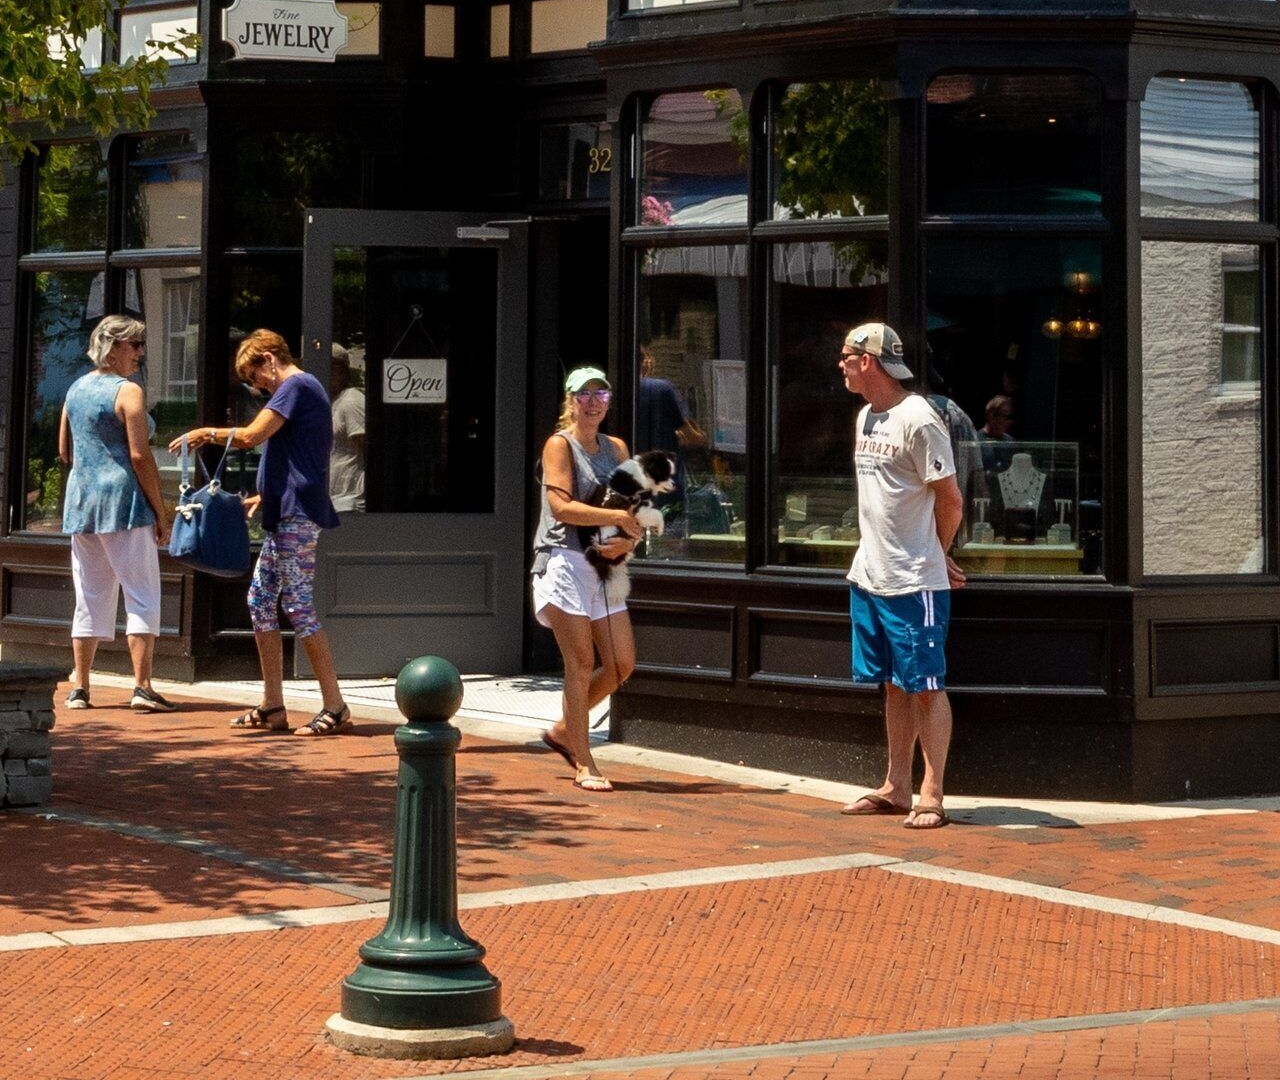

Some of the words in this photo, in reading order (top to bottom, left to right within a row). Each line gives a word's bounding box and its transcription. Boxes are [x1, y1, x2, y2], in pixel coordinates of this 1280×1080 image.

[272, 8, 300, 20] Fine
[239, 22, 334, 53] JEWELRY
[387, 363, 443, 399] Open
